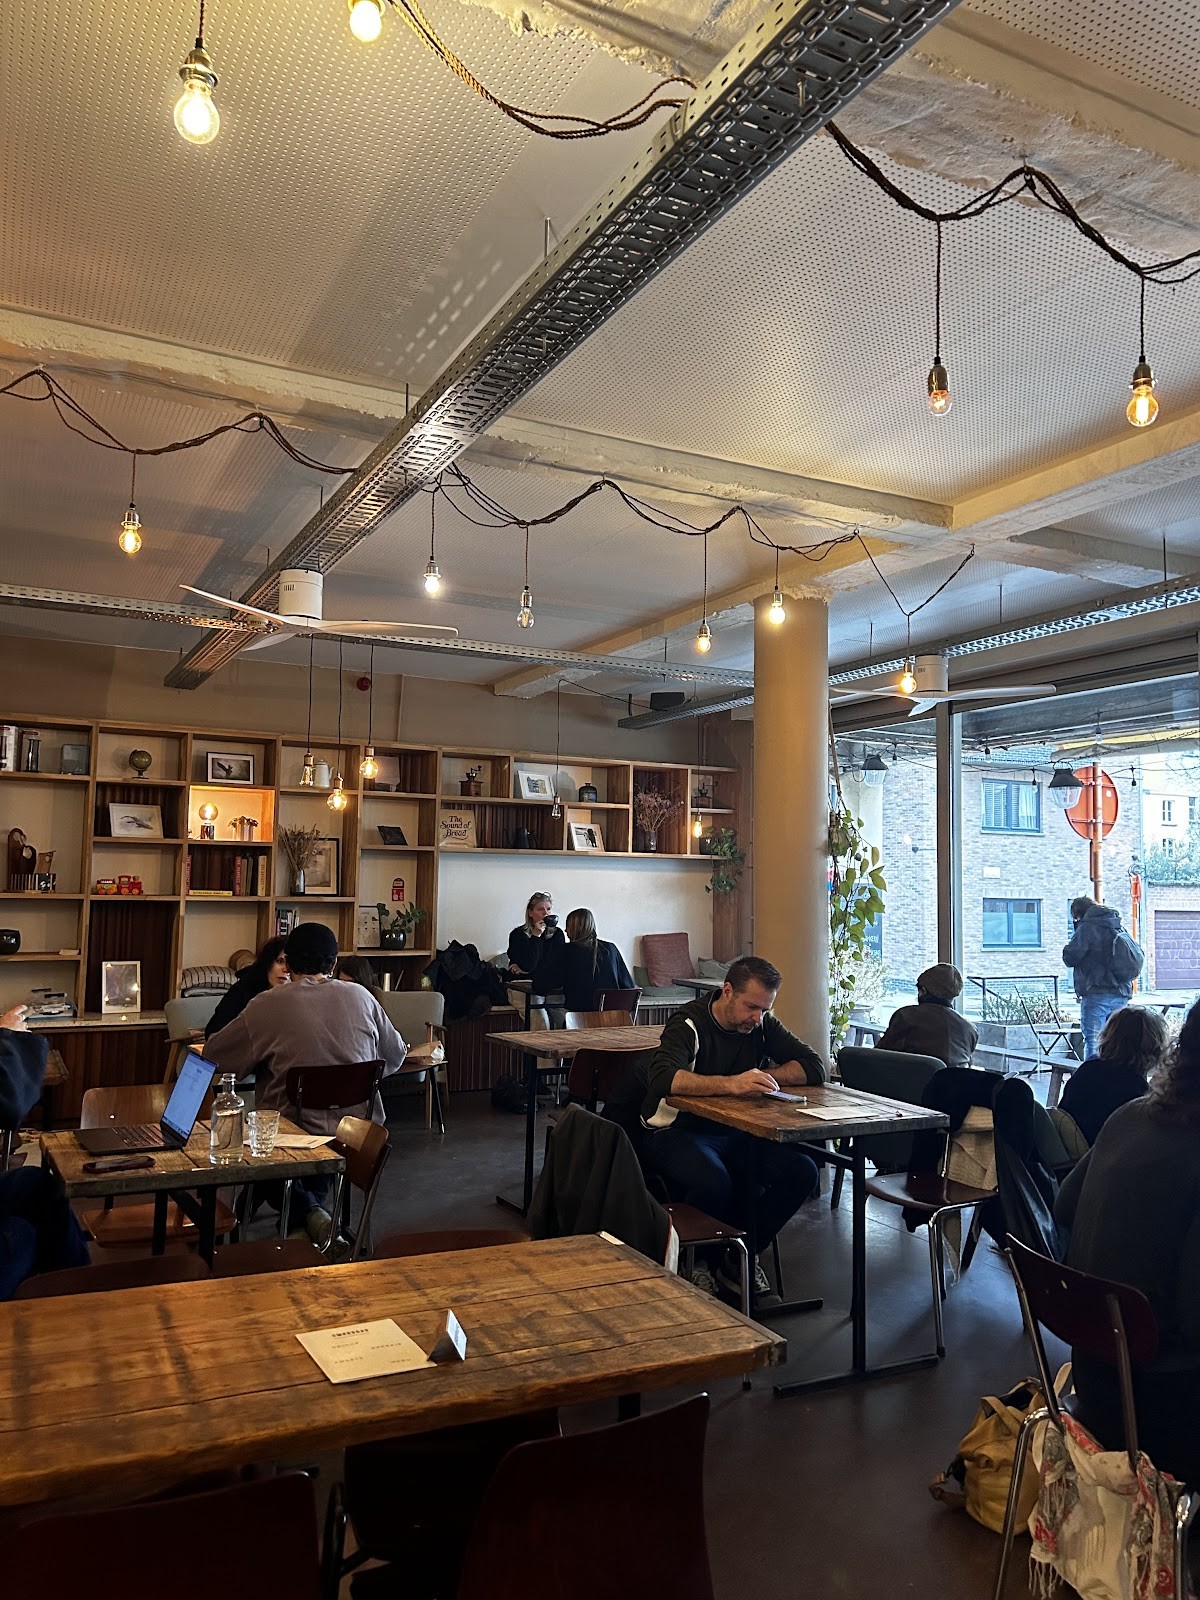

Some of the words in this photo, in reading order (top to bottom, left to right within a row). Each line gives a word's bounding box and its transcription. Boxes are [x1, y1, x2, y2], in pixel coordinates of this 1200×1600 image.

[440, 821, 462, 829] Sound
[463, 821, 472, 830] of
[443, 829, 468, 839] Bread
